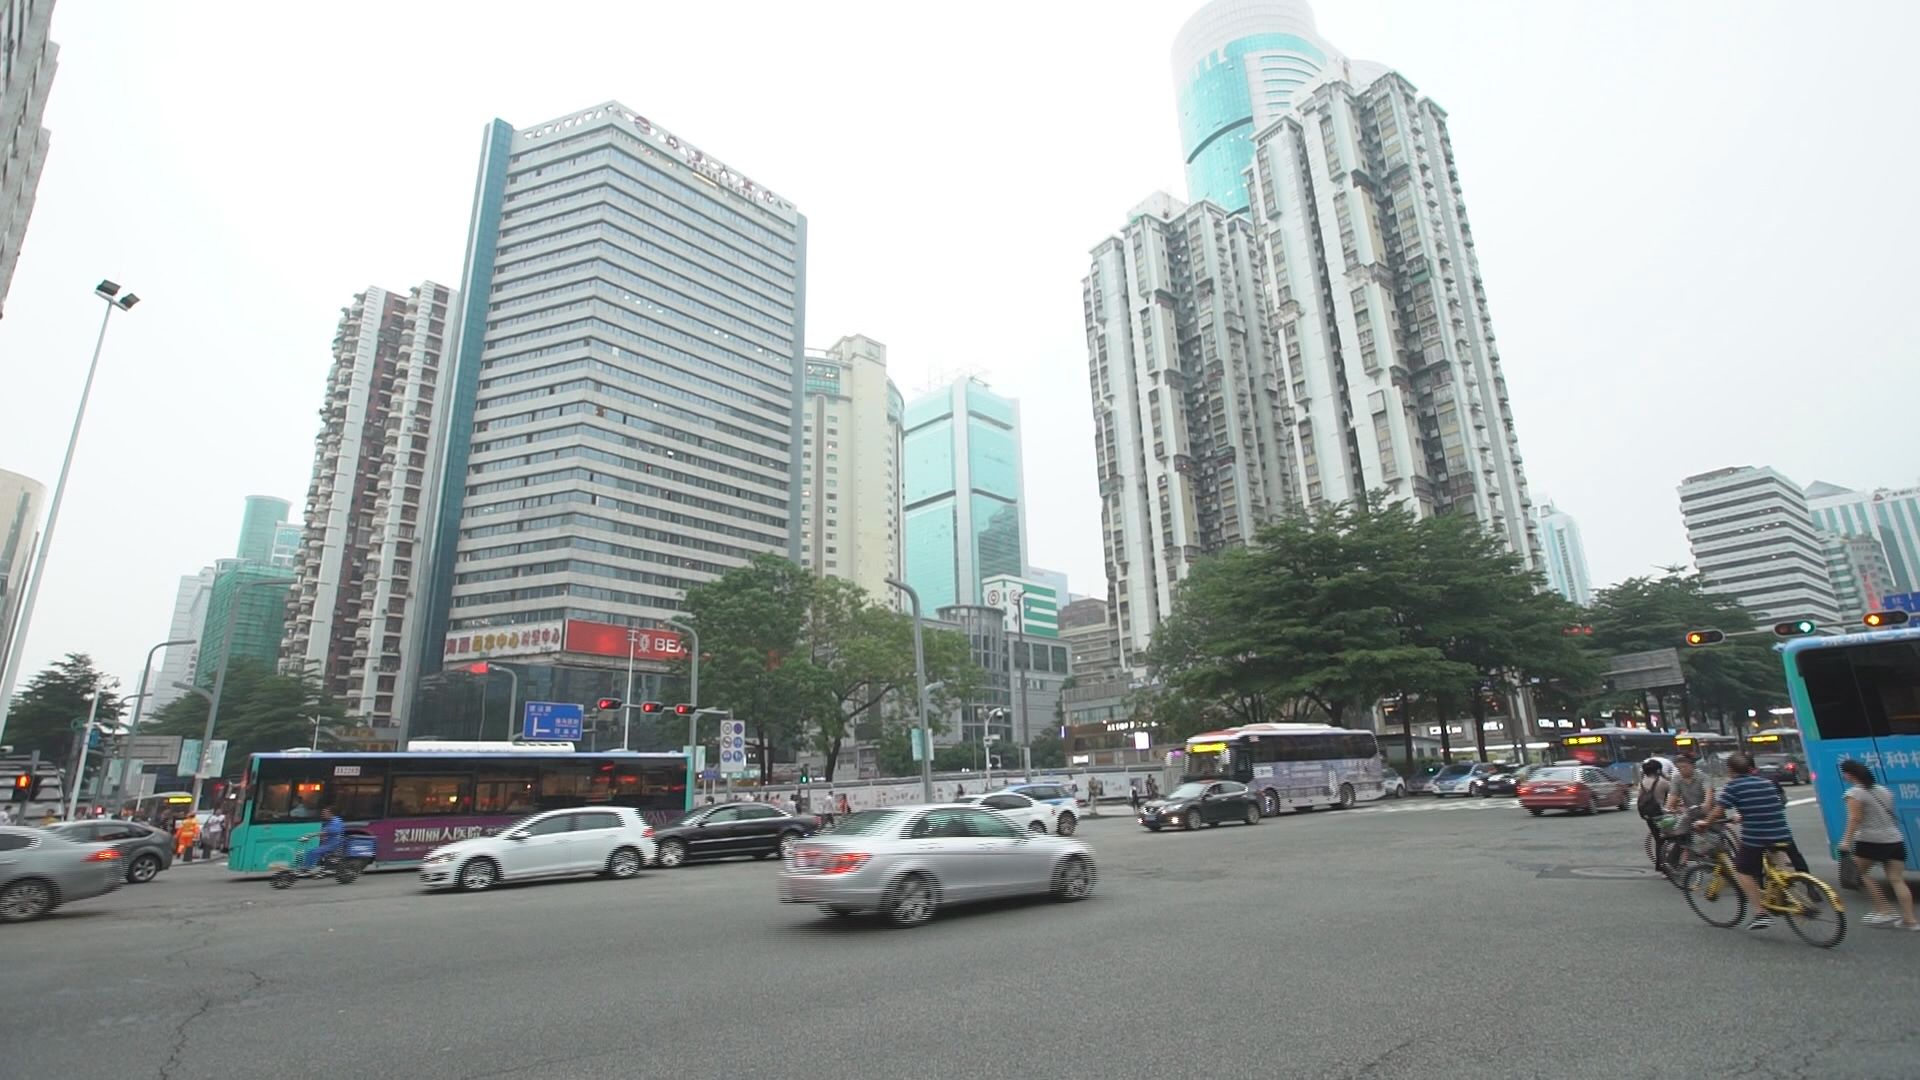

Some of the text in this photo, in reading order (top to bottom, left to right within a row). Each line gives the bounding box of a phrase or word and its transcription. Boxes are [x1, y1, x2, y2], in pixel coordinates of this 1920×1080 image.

[394, 826, 482, 843] 深圳丽人医院
